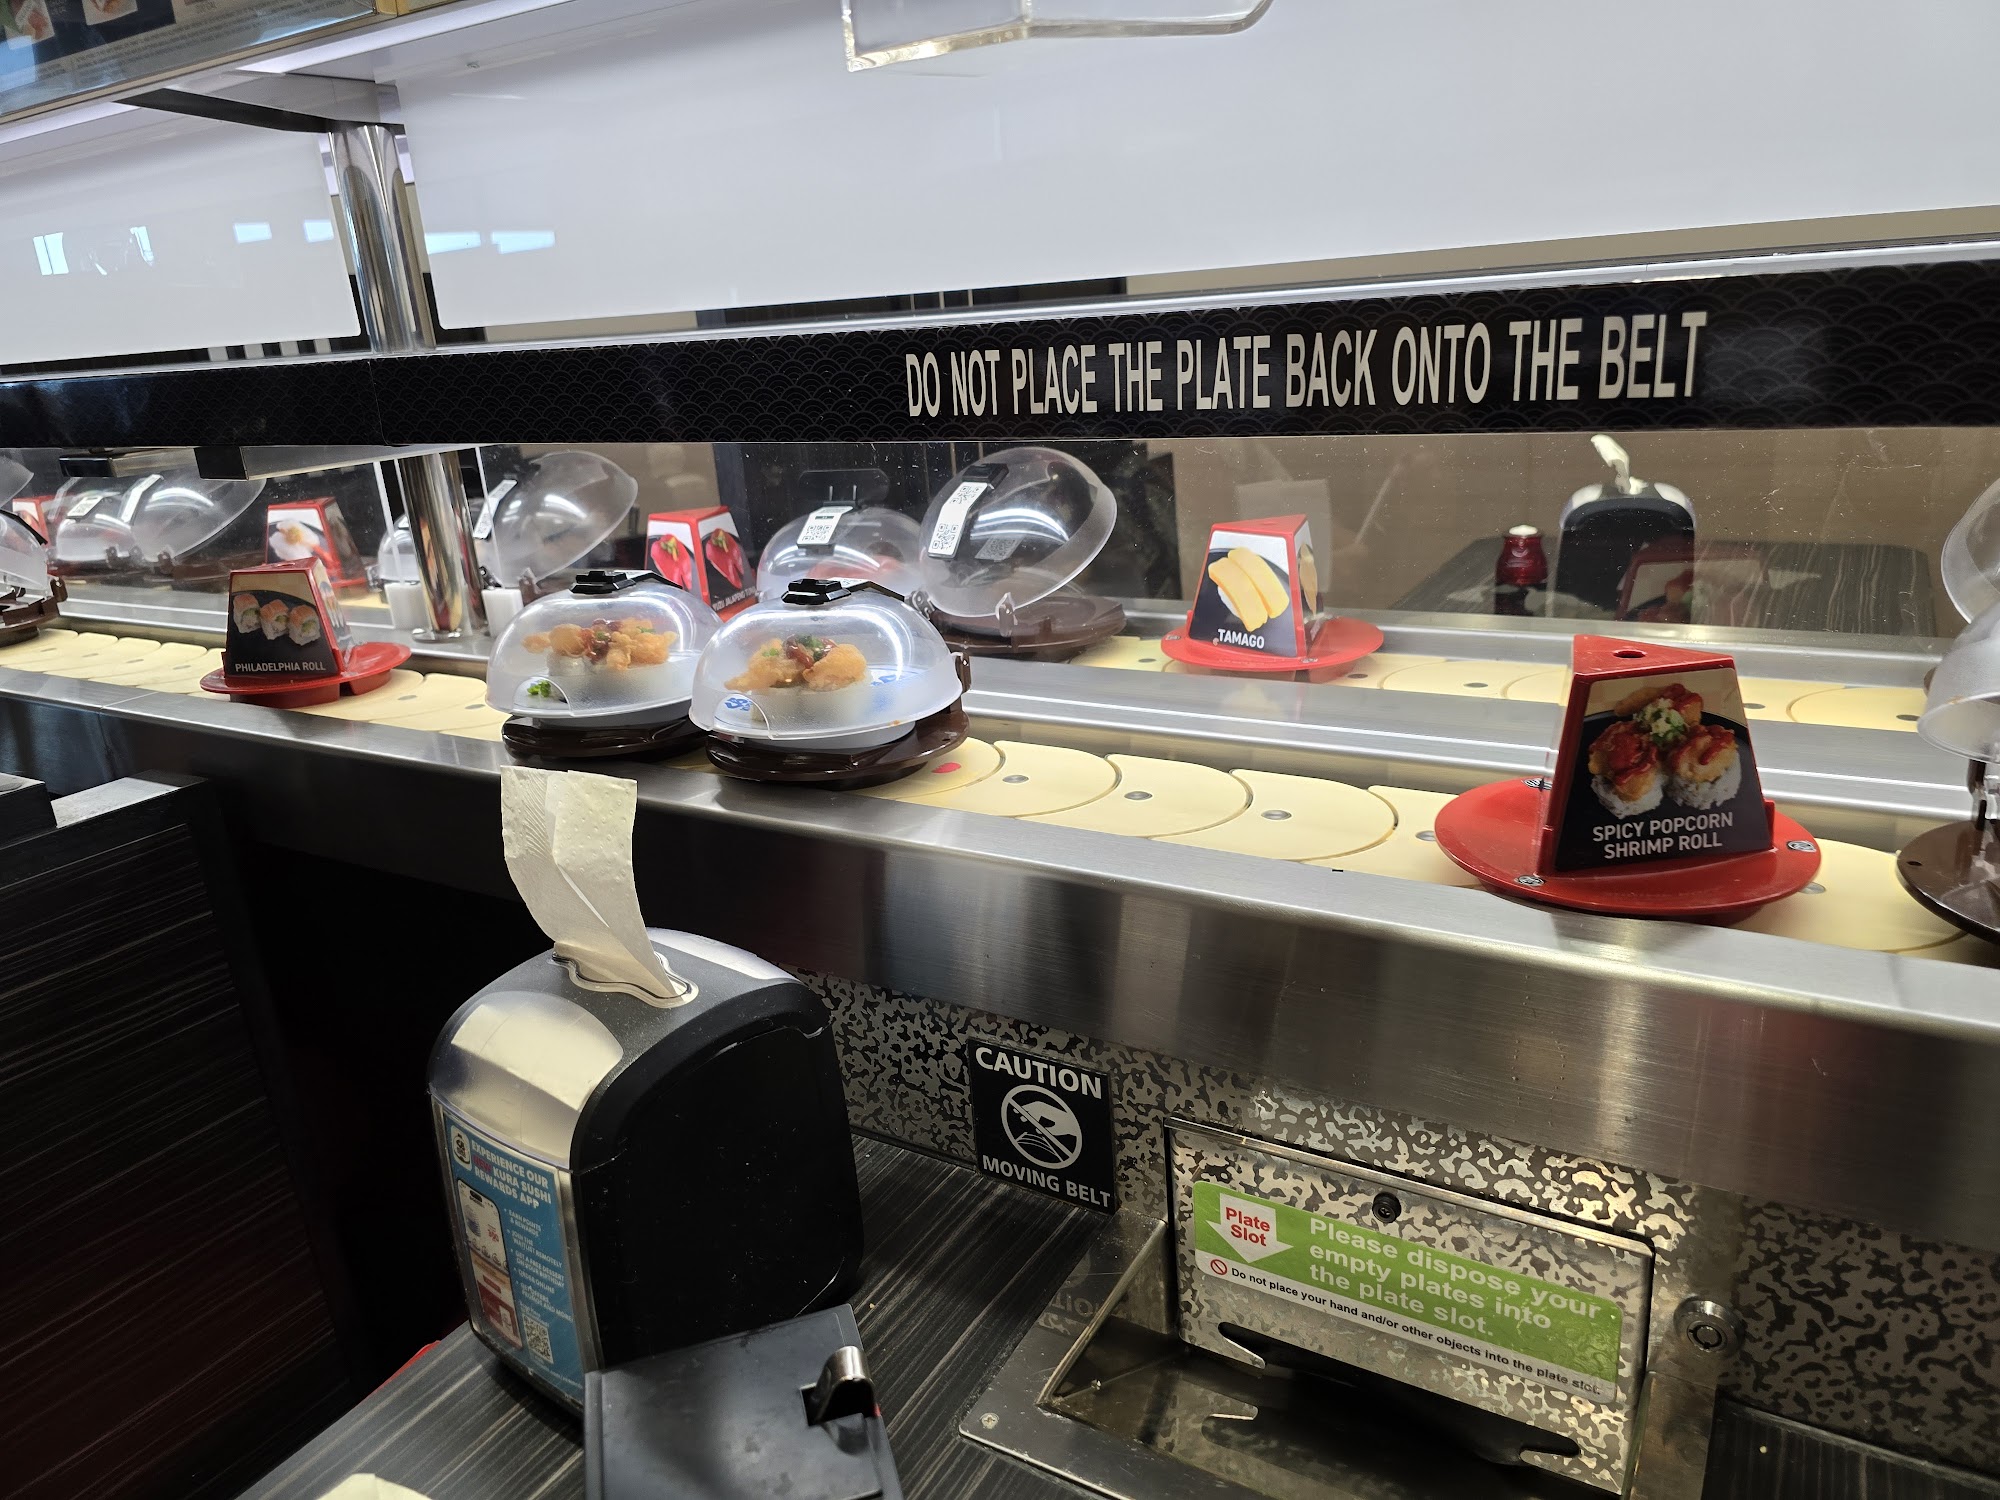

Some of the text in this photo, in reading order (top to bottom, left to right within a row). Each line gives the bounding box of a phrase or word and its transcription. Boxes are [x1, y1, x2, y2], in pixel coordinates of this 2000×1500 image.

[906, 312, 1708, 418] DO NOT PLACE THE PLATE BACK ONTO THE BELT
[1218, 628, 1265, 649] TAMAGO
[235, 661, 326, 672] PHILADELPHIA ROLL
[1592, 811, 1734, 842] SPICY POPCORN
[1604, 831, 1723, 859] SHRIMP ROLL
[975, 1047, 1102, 1099] CAUTION
[471, 1139, 525, 1178] EXPERIENCE
[526, 1170, 549, 1190] OUR
[473, 1155, 552, 1204] NEW KURA SUSHI
[475, 1166, 540, 1209] REWARDS APP
[982, 1154, 1111, 1208] MOVING BELT
[509, 1209, 541, 1232] EARN POINTS
[514, 1219, 539, 1237] REWARDS
[1225, 1206, 1271, 1232] Plate
[511, 1230, 524, 1241] JOIN
[524, 1237, 533, 1247] THE
[1231, 1224, 1267, 1247] Slot
[530, 1259, 541, 1270] FREE
[542, 1265, 565, 1282] DESSERT
[536, 1249, 562, 1268] REMOTELY
[1310, 1217, 1602, 1319] Please dispose your
[539, 1271, 564, 1288] BIRTHDAY
[1310, 1245, 1551, 1329] empty plates into
[1310, 1264, 1494, 1336] the plate slot.
[1231, 1267, 1601, 1396] Do not place your hand and/or other objects into the plate slot.
